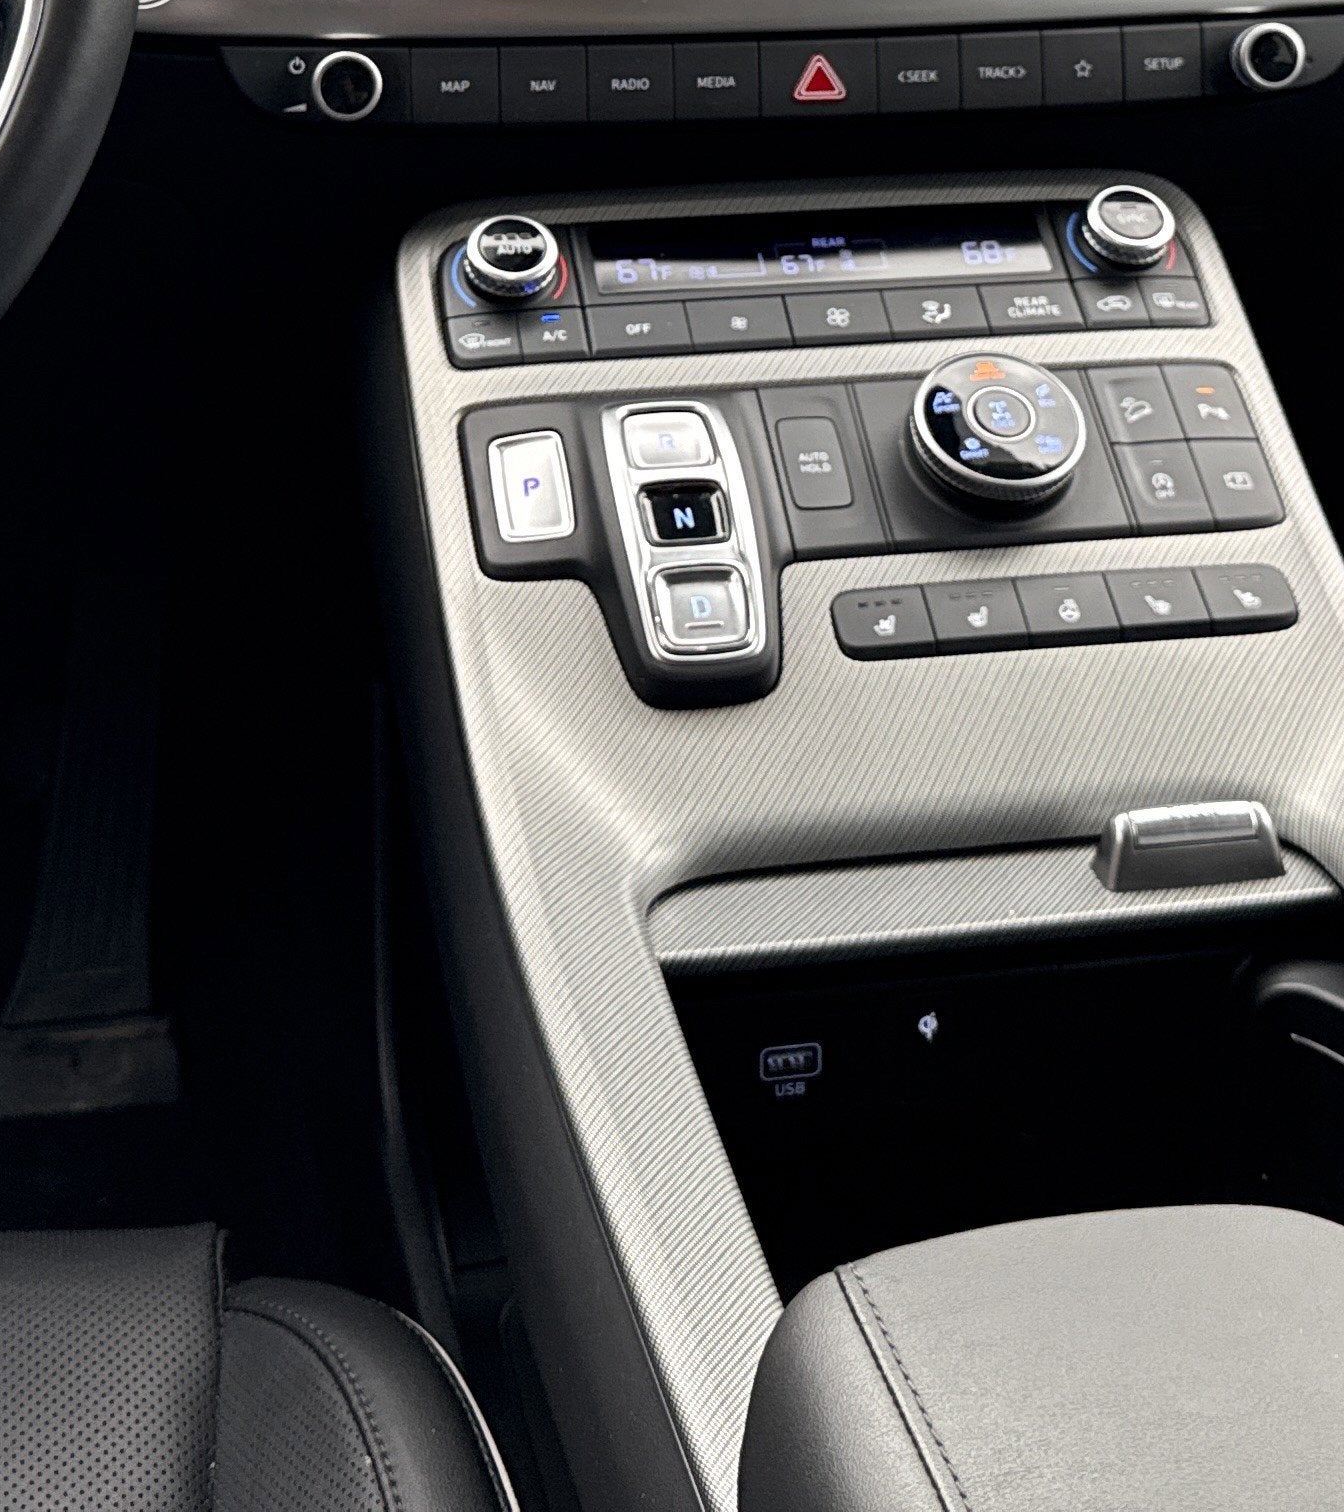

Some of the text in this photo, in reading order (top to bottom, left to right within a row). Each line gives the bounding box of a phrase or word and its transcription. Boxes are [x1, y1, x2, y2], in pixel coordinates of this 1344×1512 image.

[1144, 56, 1185, 72] SETUP
[440, 80, 471, 94] MAP
[530, 79, 556, 93] NAV
[611, 78, 650, 91] RADIO
[697, 76, 736, 90] MEDIA
[811, 237, 846, 248] REAR
[496, 244, 532, 257] AUTO
[1013, 296, 1049, 307] REAR
[1007, 305, 1062, 319] CLIMATE
[542, 330, 568, 343] A/C
[625, 323, 652, 336] OFF
[797, 451, 830, 462] AUTO
[800, 463, 832, 474] HOLD
[523, 477, 540, 497] P
[673, 506, 696, 530] N
[689, 595, 712, 619] D
[774, 1081, 806, 1097] USB
